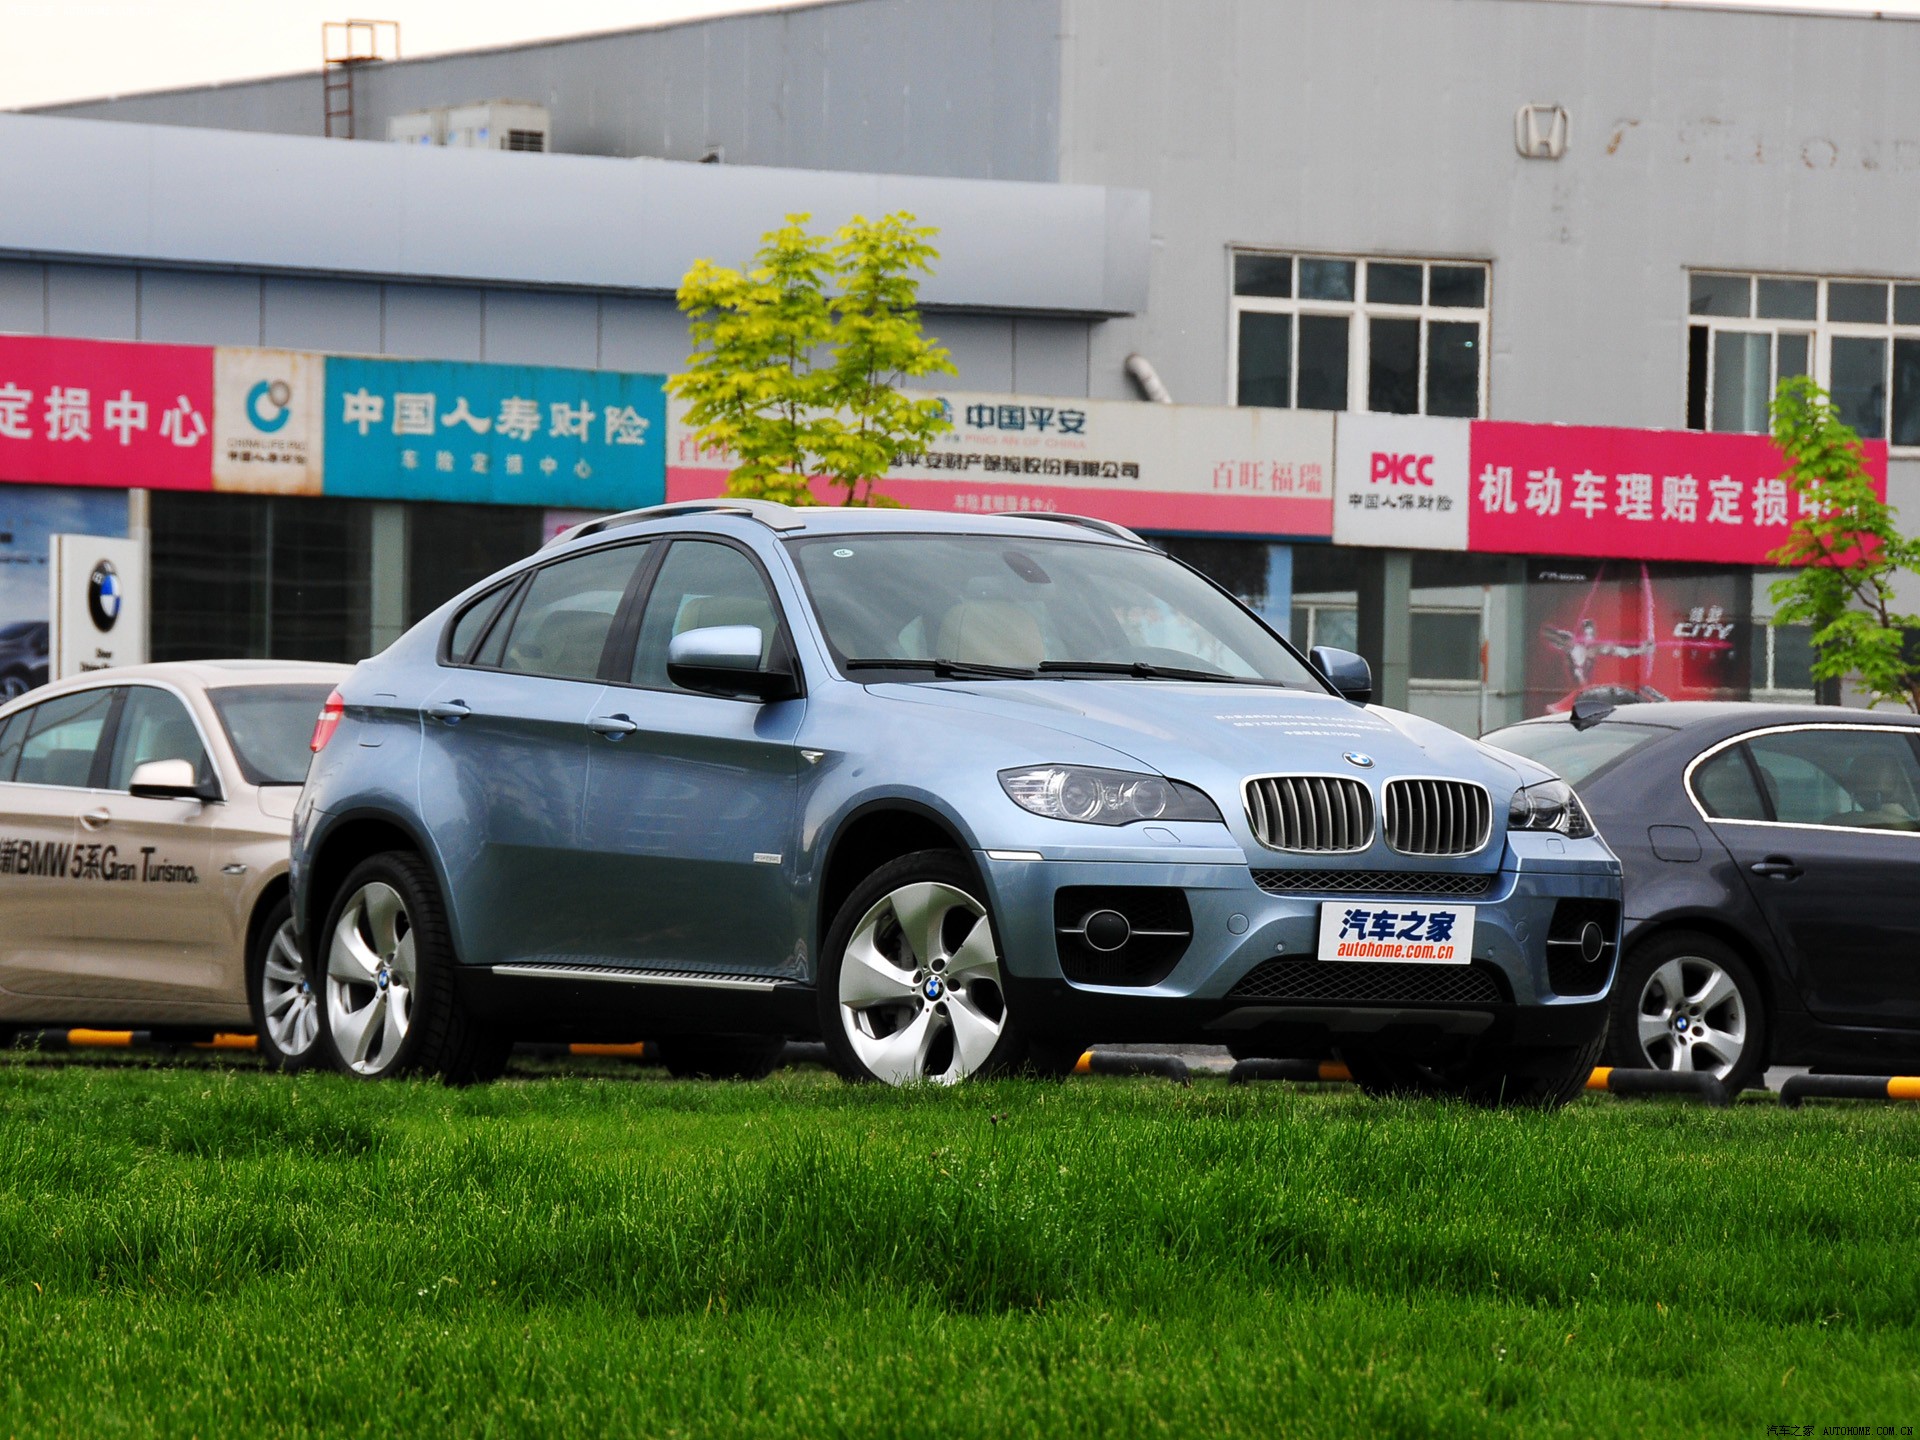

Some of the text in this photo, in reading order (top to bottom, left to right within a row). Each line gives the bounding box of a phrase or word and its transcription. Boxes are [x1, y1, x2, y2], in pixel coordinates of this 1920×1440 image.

[0, 382, 208, 447] 定损中心
[342, 388, 650, 446] 中国人寿财险
[966, 404, 1086, 435] 中国平安
[1211, 458, 1323, 494] 百旺福瑞
[1370, 451, 1435, 486] PICC
[1348, 493, 1454, 512] 中国人保财险
[1338, 908, 1456, 942] 汽车之家
[1337, 941, 1454, 960] autohome.com.cn
